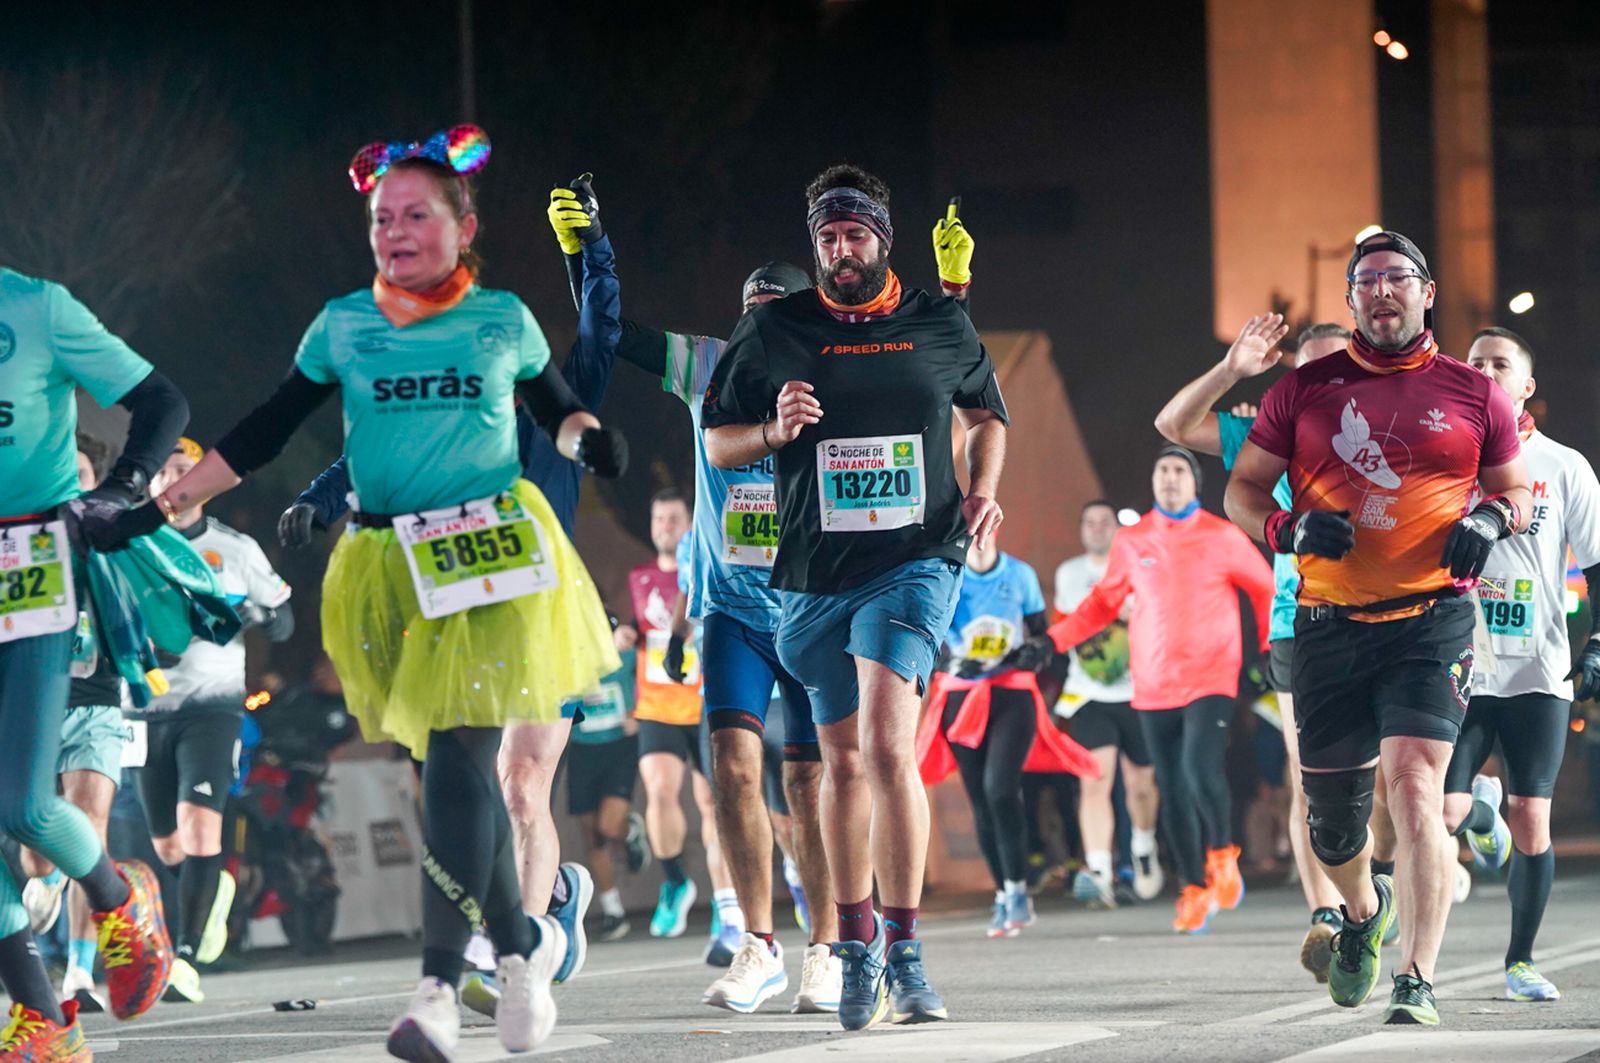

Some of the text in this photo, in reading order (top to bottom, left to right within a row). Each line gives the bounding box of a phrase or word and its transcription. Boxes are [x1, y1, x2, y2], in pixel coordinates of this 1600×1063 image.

[833, 342, 914, 355] SPEED RUN
[372, 367, 484, 403] serás
[840, 447, 885, 458] NOCHE DE
[829, 460, 849, 470] SAN
[851, 456, 885, 470] ANTÓN
[1352, 447, 1382, 473] 43
[831, 469, 912, 500] 13220
[743, 492, 771, 501] NOCHE
[732, 502, 751, 512] SAN
[1361, 504, 1387, 517] SAN
[416, 527, 442, 541] SAN
[430, 523, 523, 573] 5855
